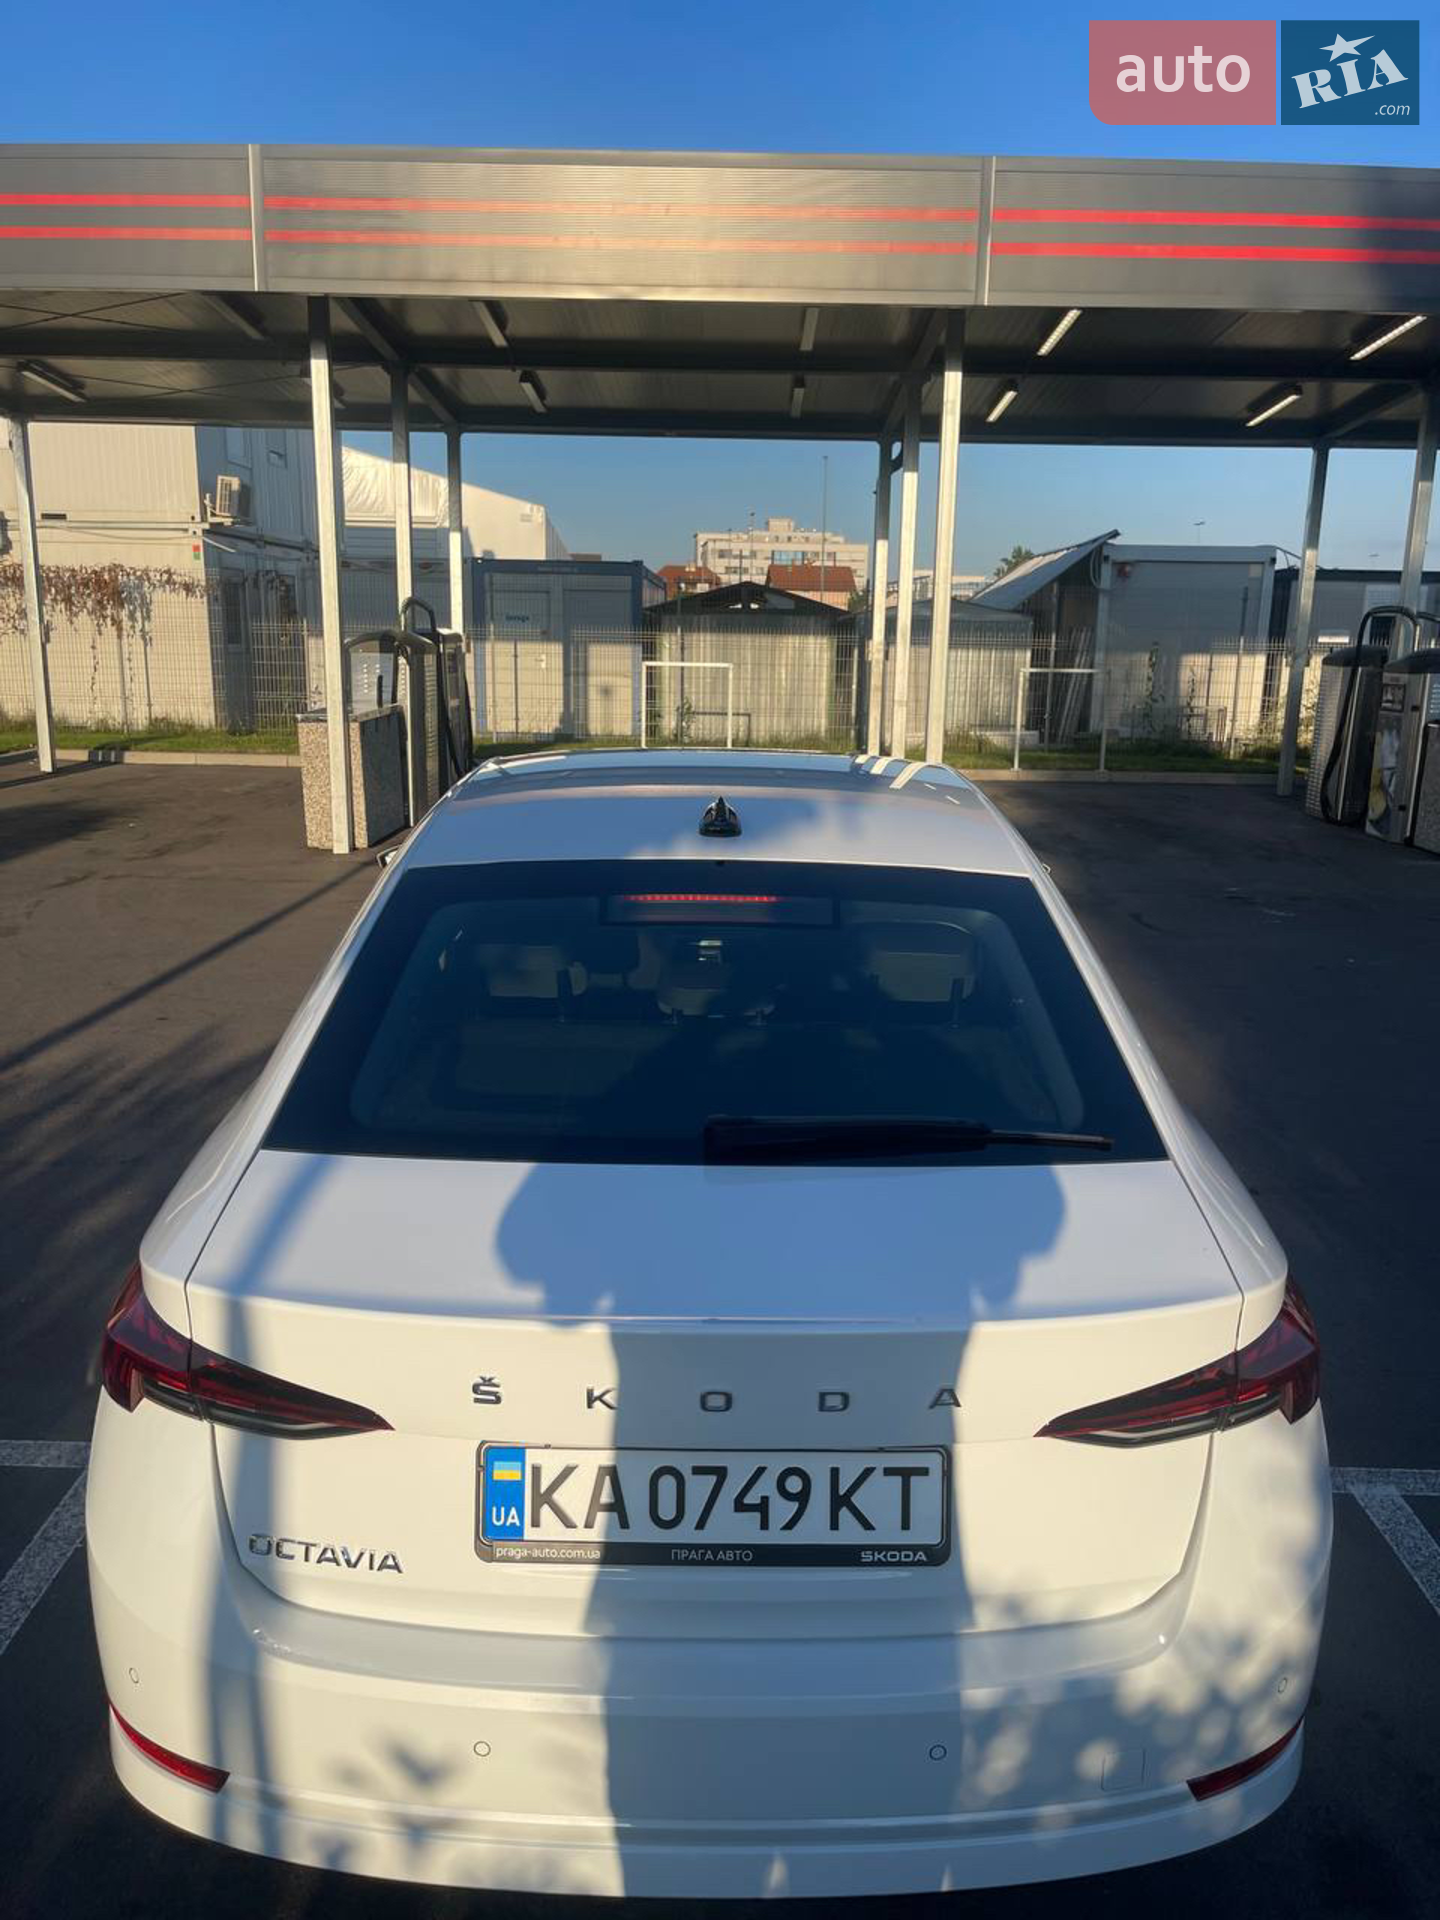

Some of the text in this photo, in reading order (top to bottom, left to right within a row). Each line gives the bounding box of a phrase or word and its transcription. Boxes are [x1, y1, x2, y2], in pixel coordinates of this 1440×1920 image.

[492, 1507, 520, 1527] UA
[249, 1533, 403, 1574] OCTAVIA
[495, 1546, 601, 1560] praga-auto.com.ua
[671, 1550, 753, 1561] ПРАГА АВТО
[860, 1550, 927, 1562] SKODA
